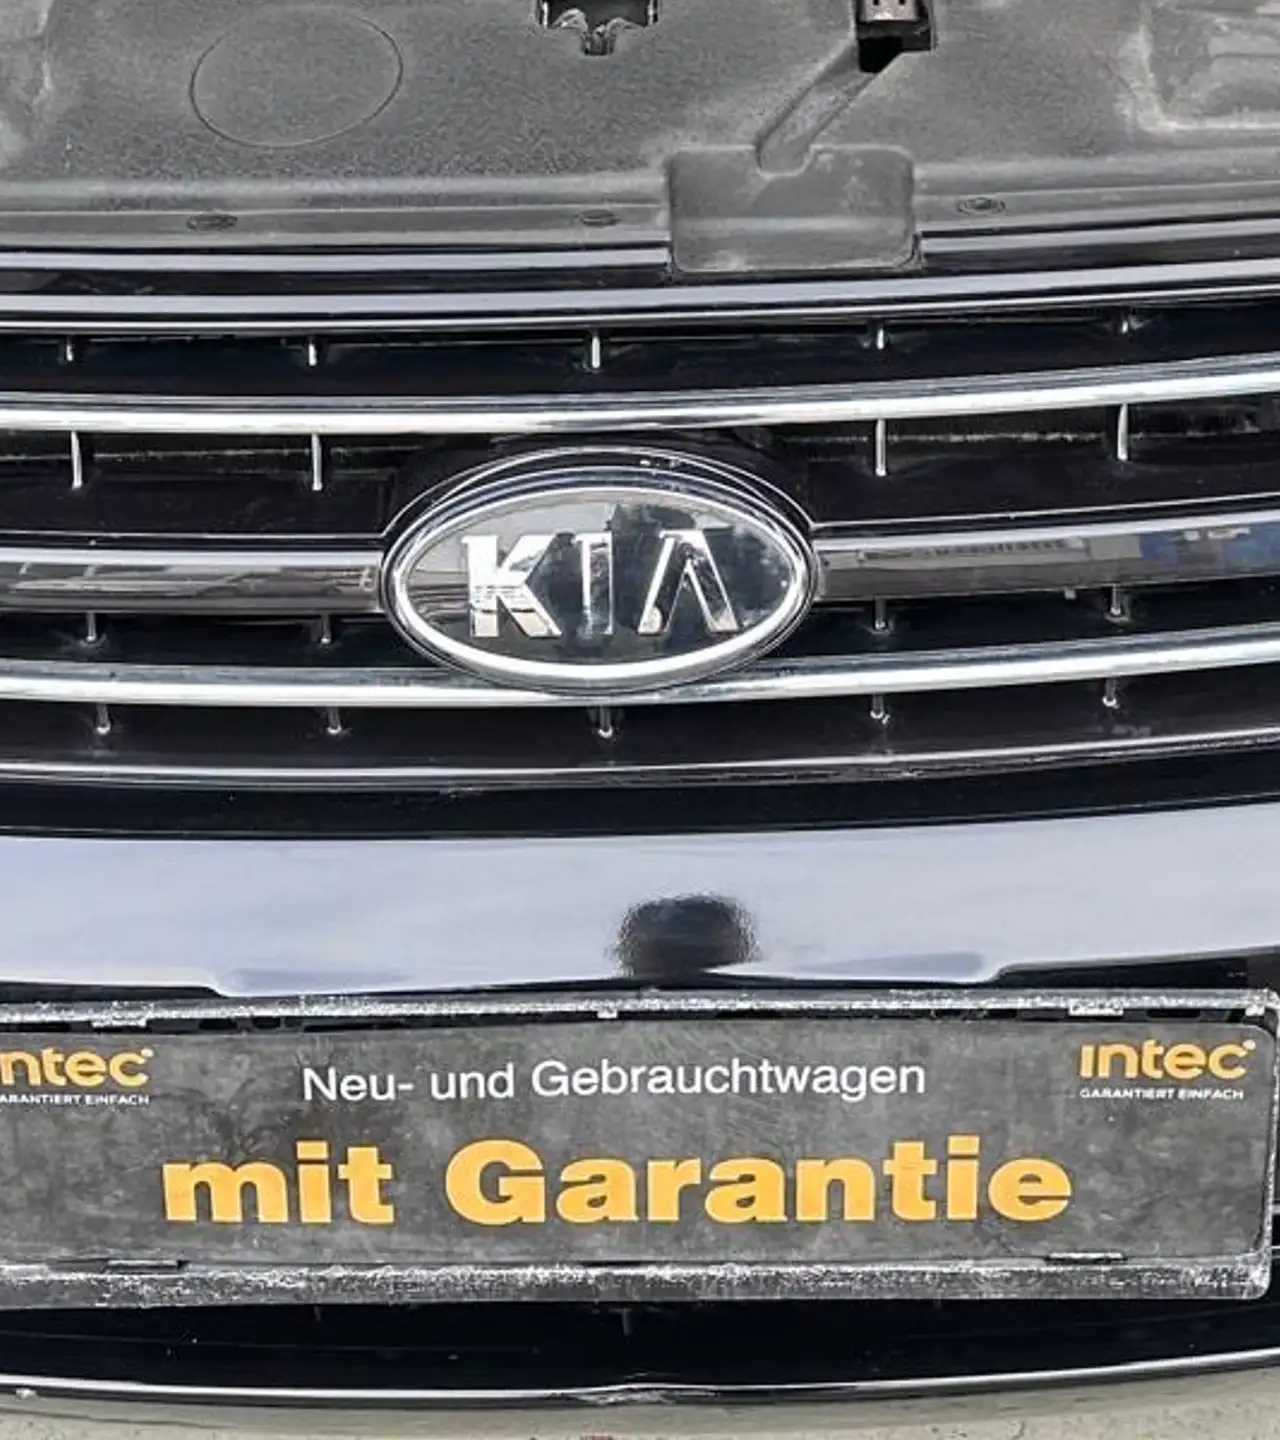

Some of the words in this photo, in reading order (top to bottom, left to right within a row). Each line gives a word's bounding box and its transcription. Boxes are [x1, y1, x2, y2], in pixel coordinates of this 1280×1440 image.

[461, 529, 745, 640] KIA
[85, 1093, 150, 1106] EINFACH
[301, 1065, 415, 1101] Neu-
[430, 1062, 515, 1100] und
[530, 1058, 925, 1103] Gebrauchtwagen
[1079, 1087, 1174, 1101] GARANTIERT
[1177, 1087, 1245, 1101] EINFACH
[161, 1141, 395, 1225] mit
[443, 1135, 1074, 1226] Garantie
